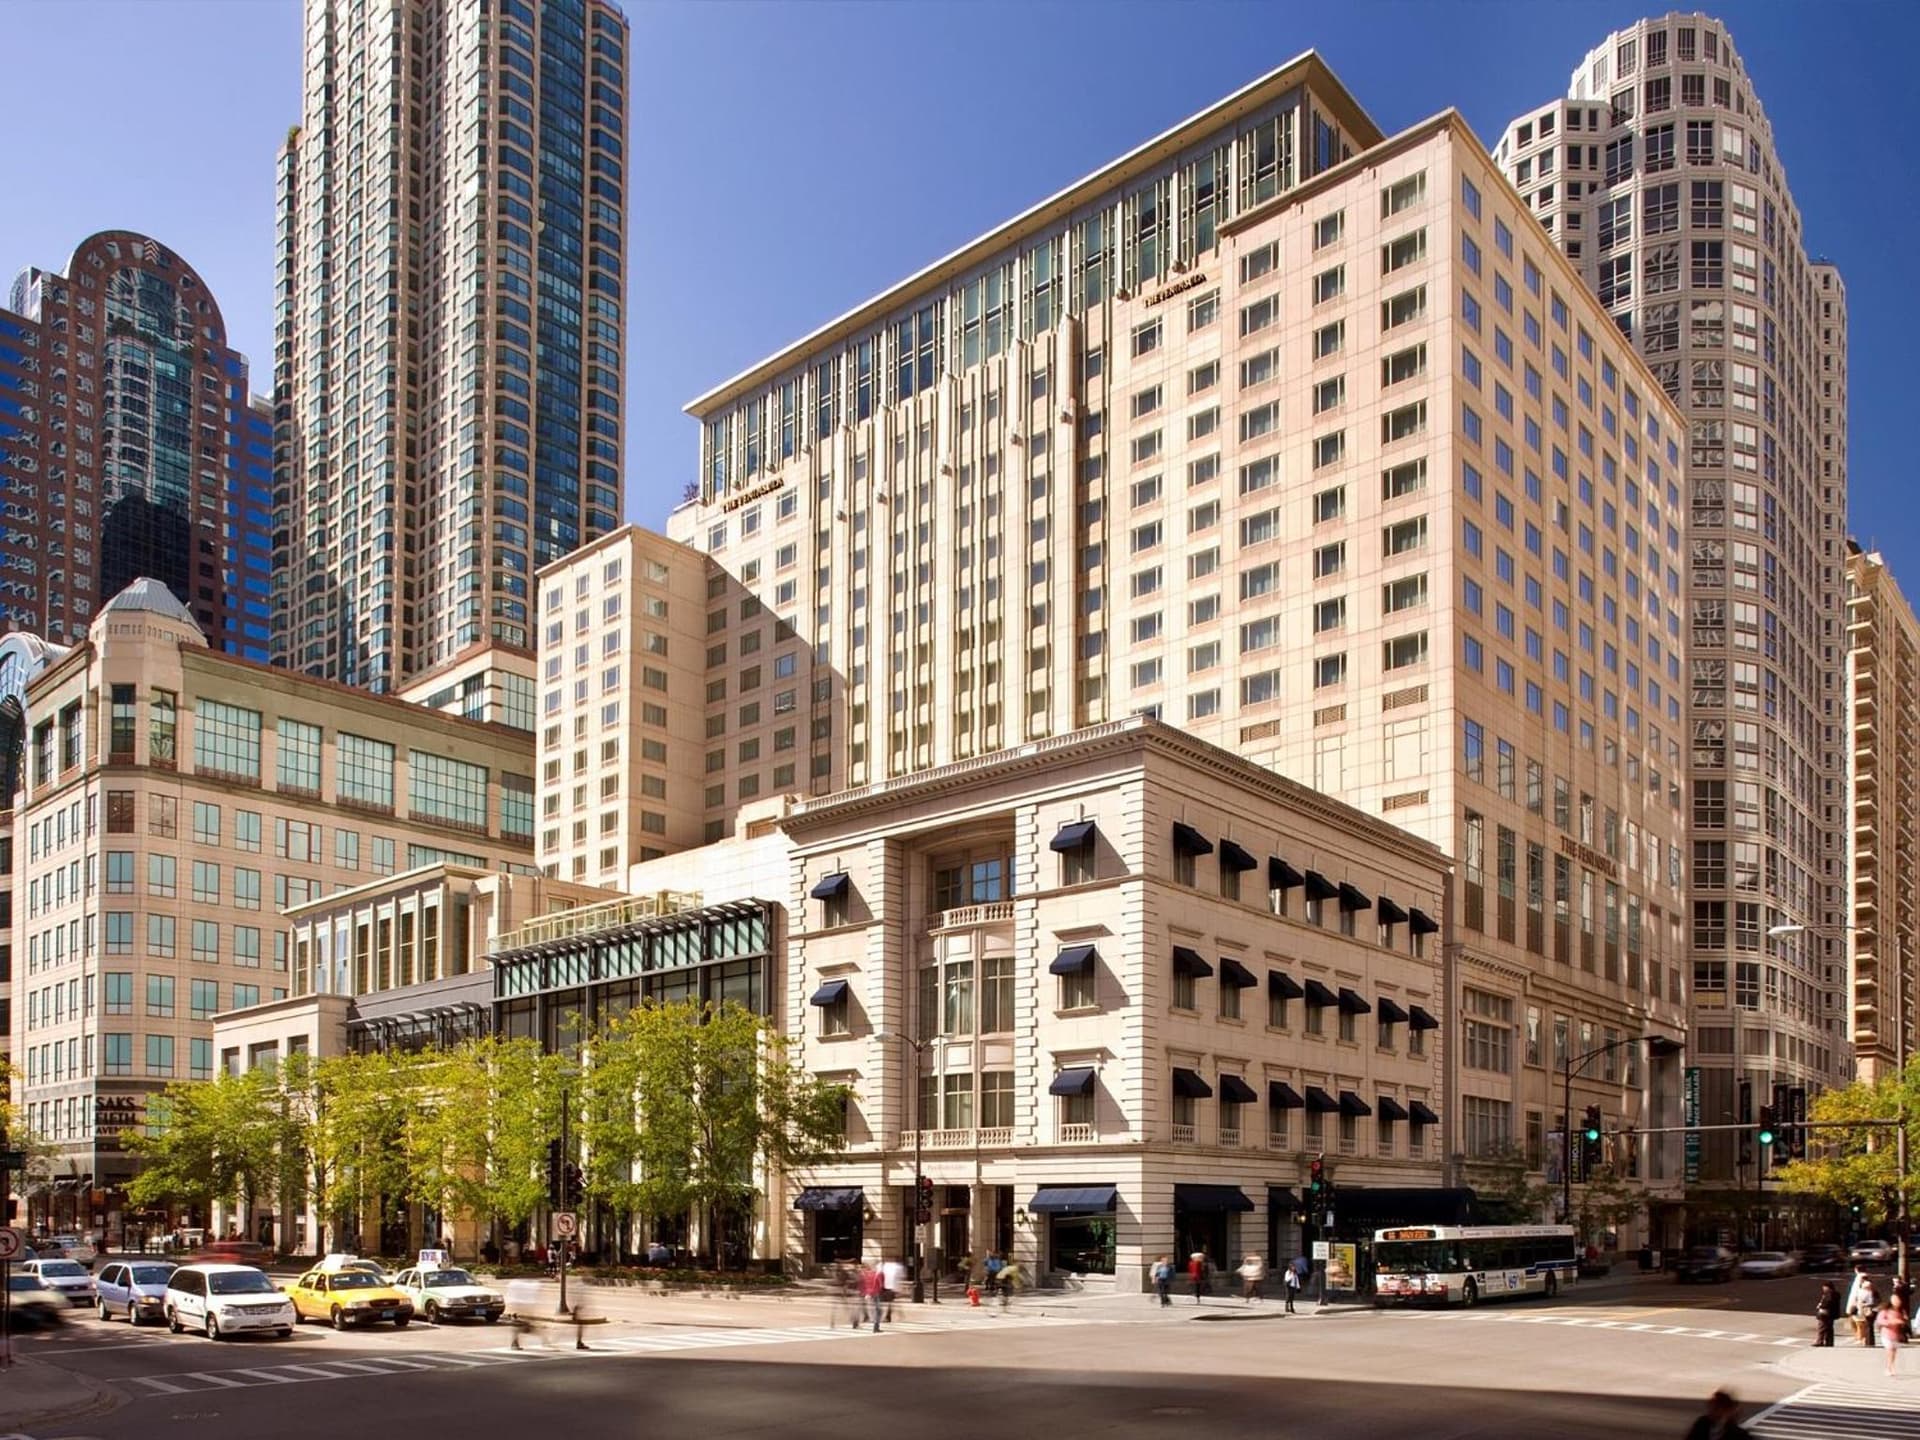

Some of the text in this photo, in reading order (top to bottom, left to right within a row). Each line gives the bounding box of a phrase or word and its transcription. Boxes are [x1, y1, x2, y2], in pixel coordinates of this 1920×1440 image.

[1560, 835, 1577, 858] THE
[96, 1096, 135, 1108] SAKS
[96, 1112, 136, 1124] FIFTH
